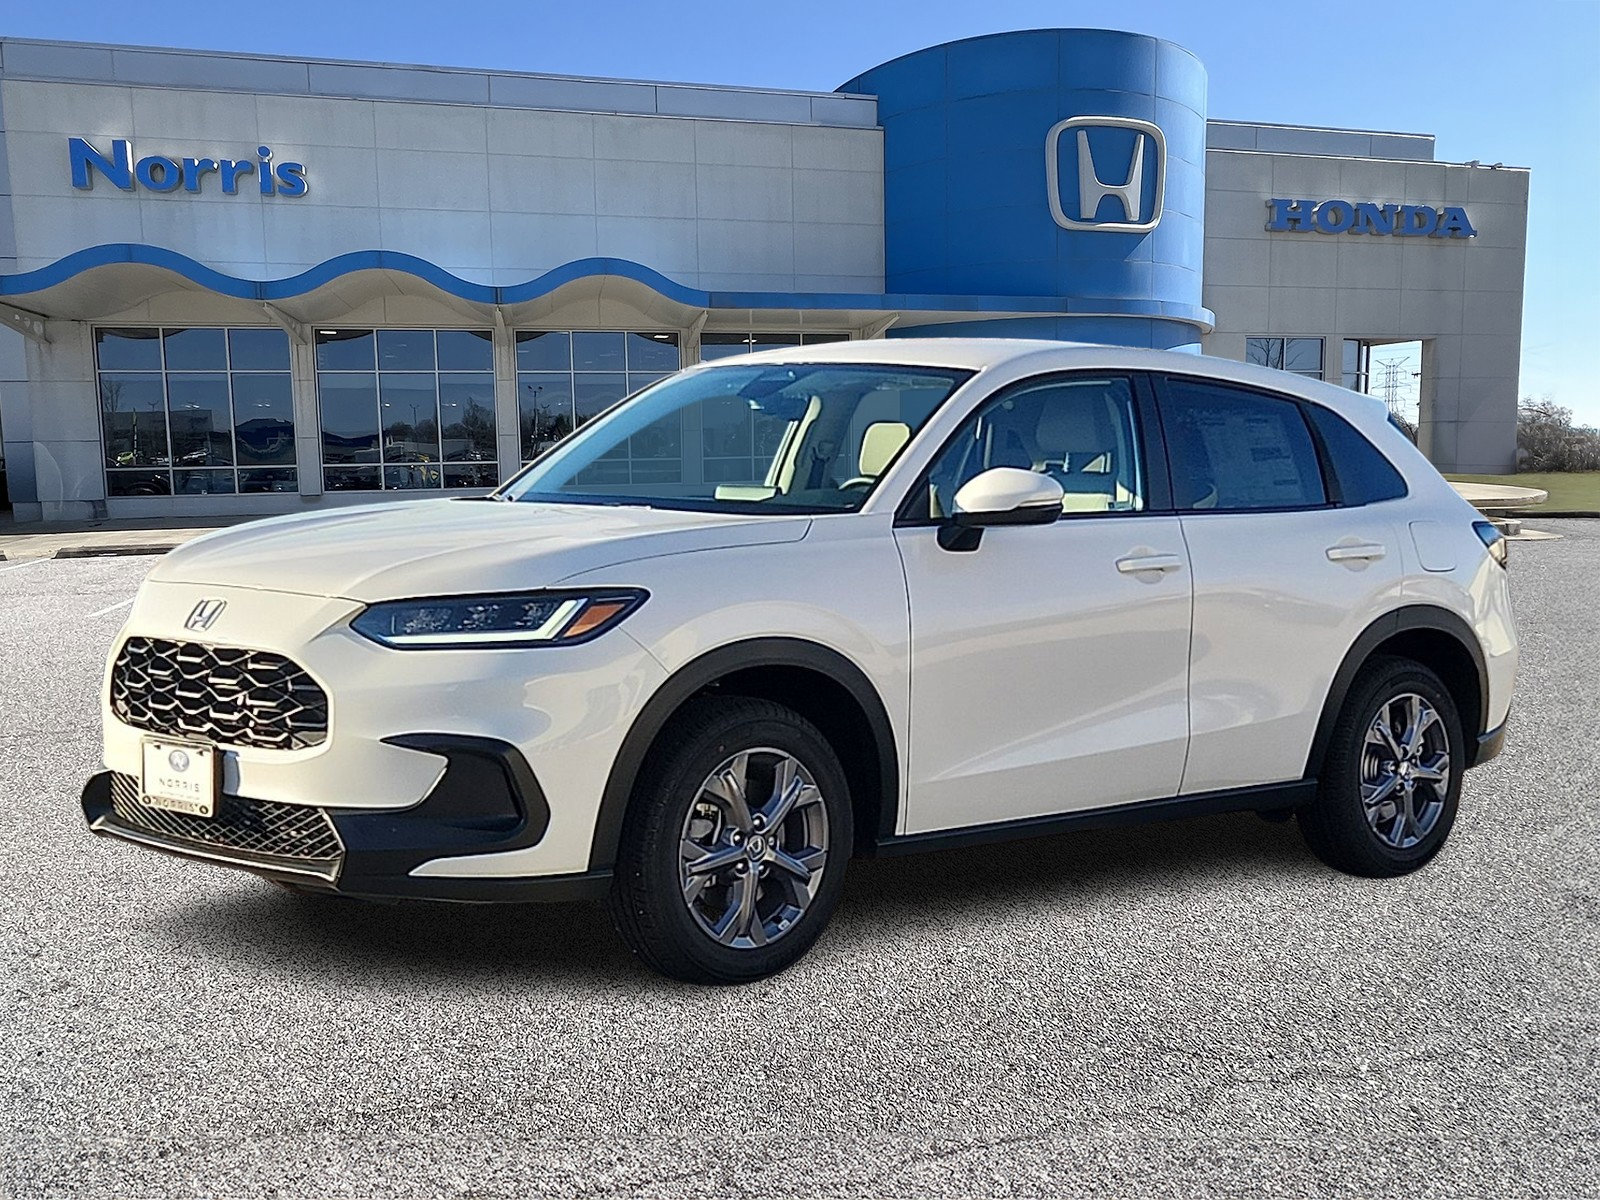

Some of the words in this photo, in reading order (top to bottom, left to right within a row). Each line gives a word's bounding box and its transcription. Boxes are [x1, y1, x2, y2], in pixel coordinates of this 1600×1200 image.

[68, 137, 309, 197] Norris
[1266, 198, 1477, 239] HONDA
[159, 777, 200, 793] NORRIS
